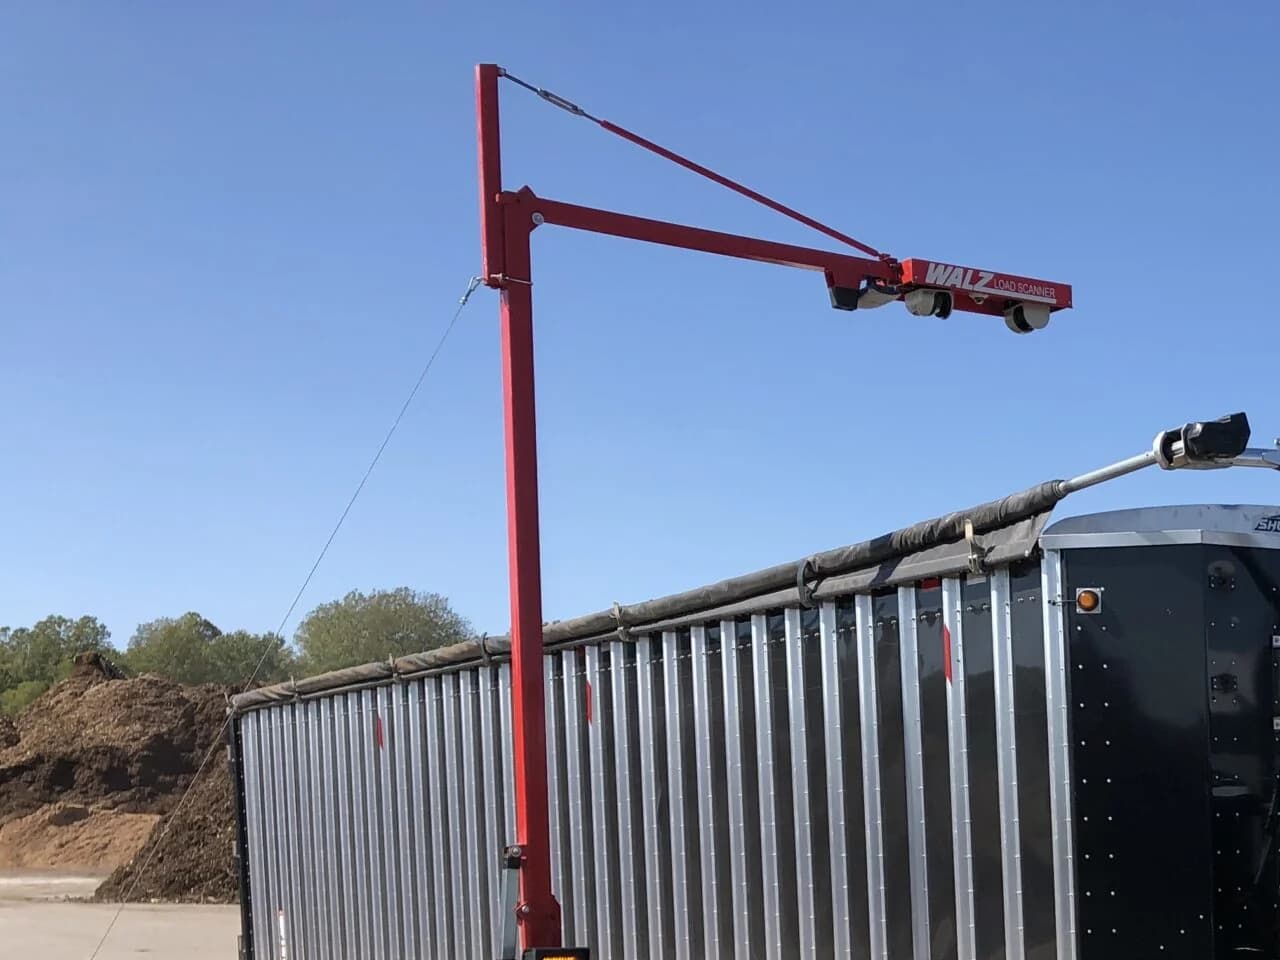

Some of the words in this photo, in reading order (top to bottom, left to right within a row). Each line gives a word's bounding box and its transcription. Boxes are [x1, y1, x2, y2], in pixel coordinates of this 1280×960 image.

[925, 262, 995, 291] WALZ
[994, 278, 1018, 292] LOAD
[1018, 281, 1056, 298] SCANNER
